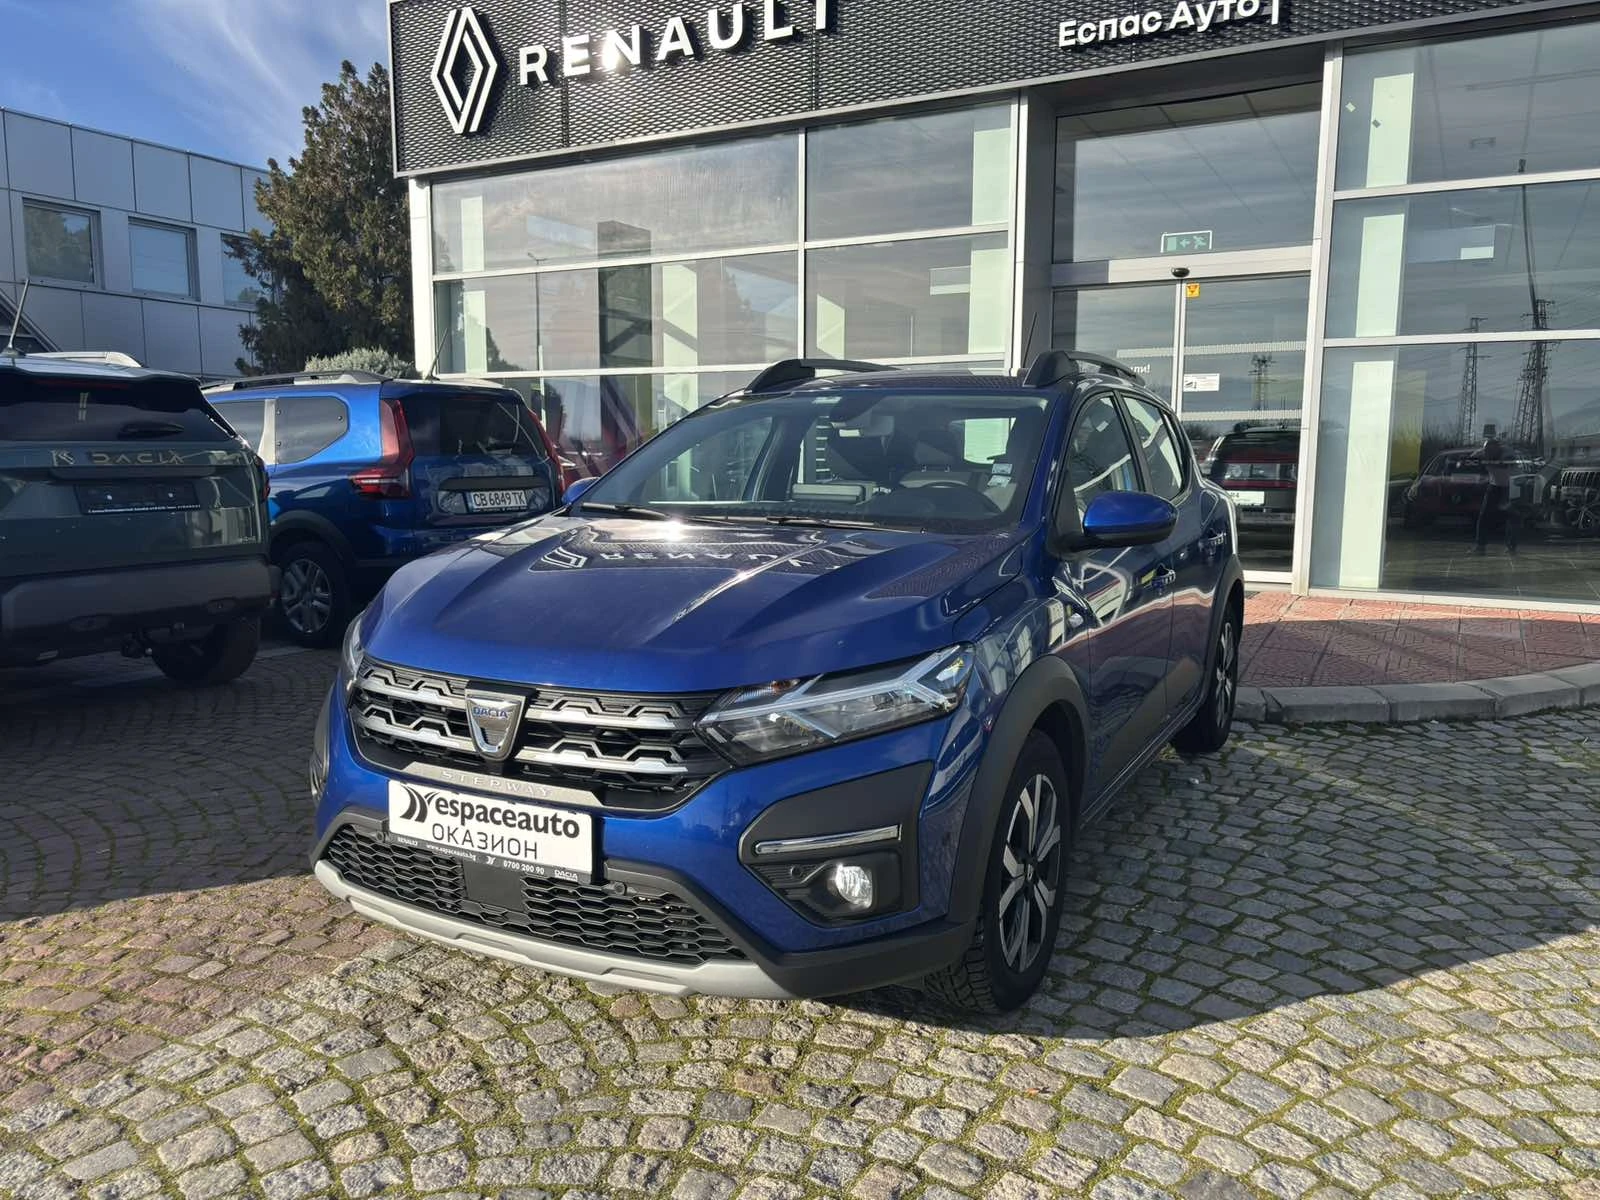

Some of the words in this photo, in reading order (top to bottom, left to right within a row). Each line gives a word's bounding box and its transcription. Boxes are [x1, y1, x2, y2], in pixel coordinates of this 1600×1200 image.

[1058, 18, 1163, 48] Еспас
[1168, 0, 1260, 33] Ауто
[474, 493, 488, 506] CB
[489, 492, 511, 506] 6849
[512, 492, 525, 505] TK
[441, 770, 552, 797] STEPWAY
[435, 796, 580, 839] espaceauto
[432, 823, 538, 860] ОКАЗИОН
[503, 859, 520, 870] 0700
